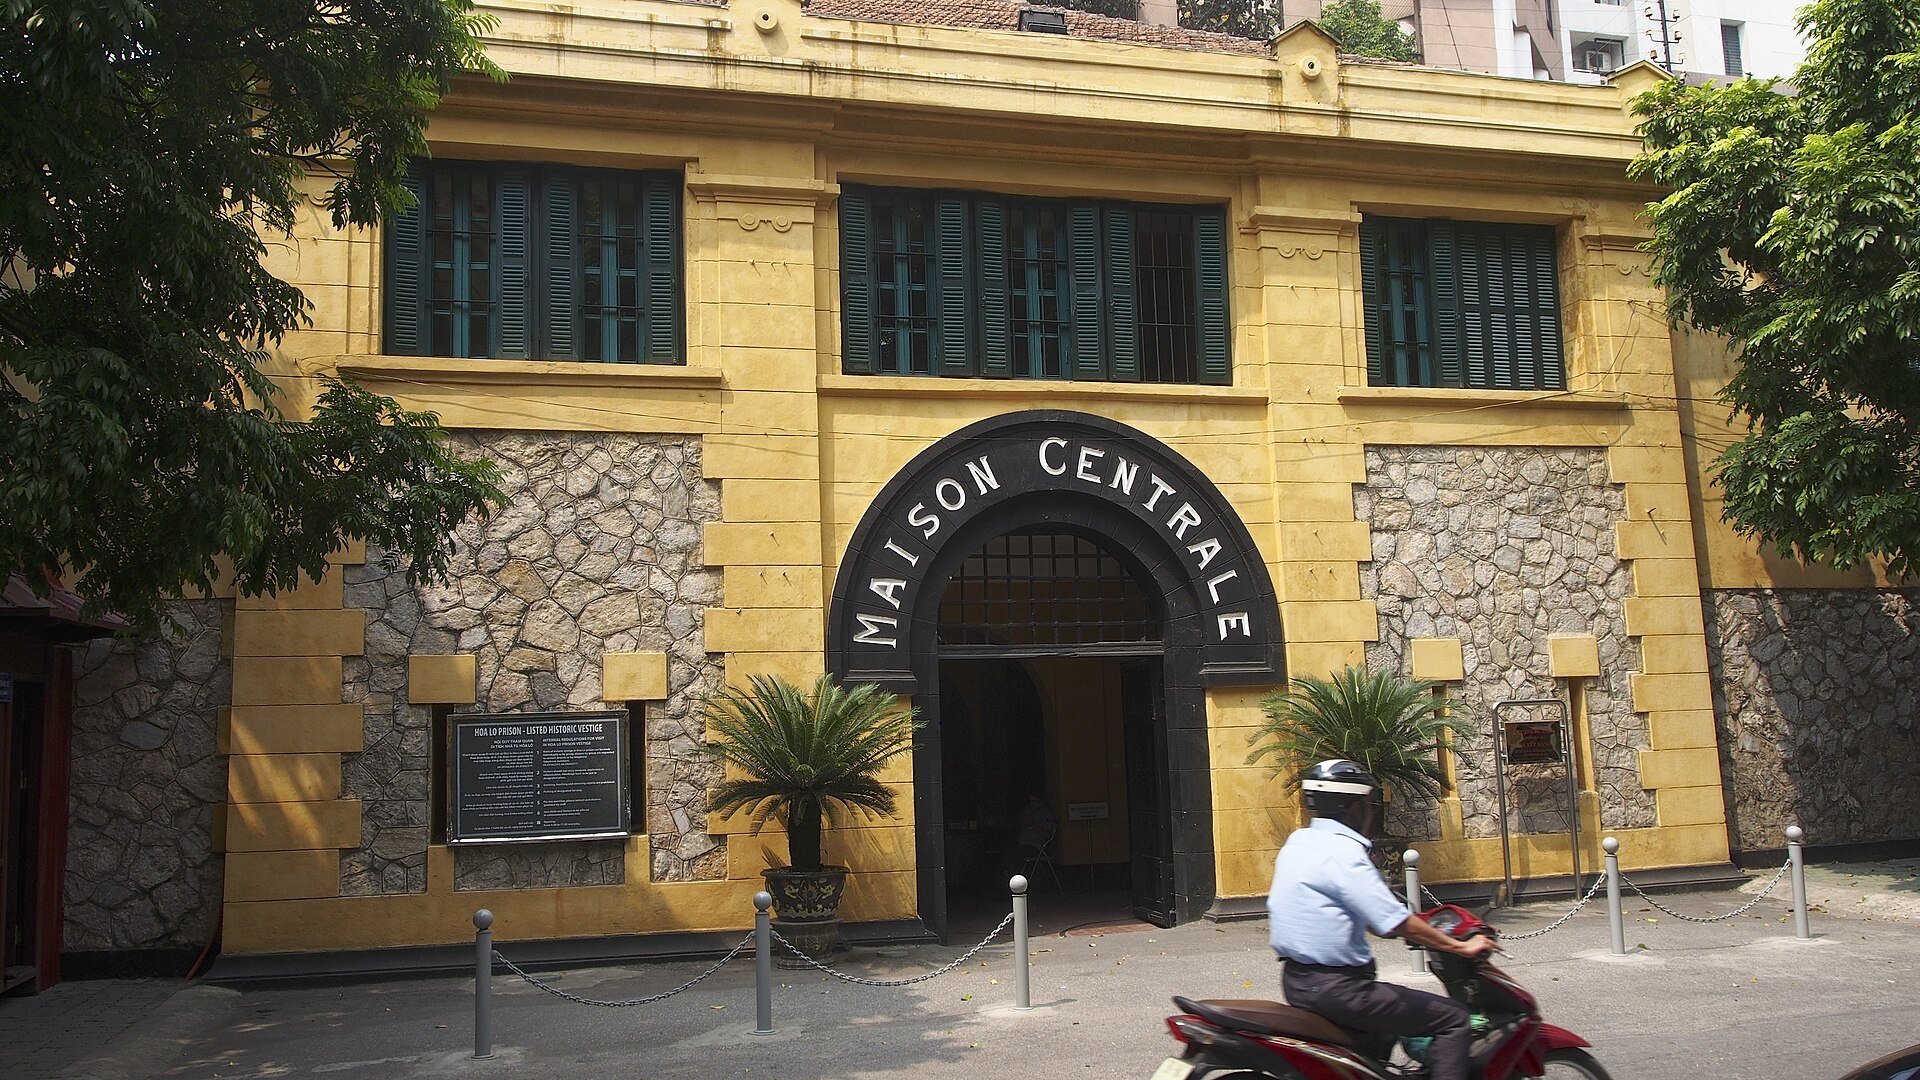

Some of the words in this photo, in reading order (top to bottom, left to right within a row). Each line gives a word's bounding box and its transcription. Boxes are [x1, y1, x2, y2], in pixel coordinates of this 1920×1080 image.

[852, 454, 1001, 649] MAISON
[1038, 436, 1251, 642] CENTRALE
[474, 728, 488, 737] HOA
[490, 727, 497, 736] LO
[498, 726, 521, 735] PRISON
[526, 726, 548, 734] LISTED
[548, 724, 577, 734] HISTORIC
[578, 724, 602, 732] VESTIGE
